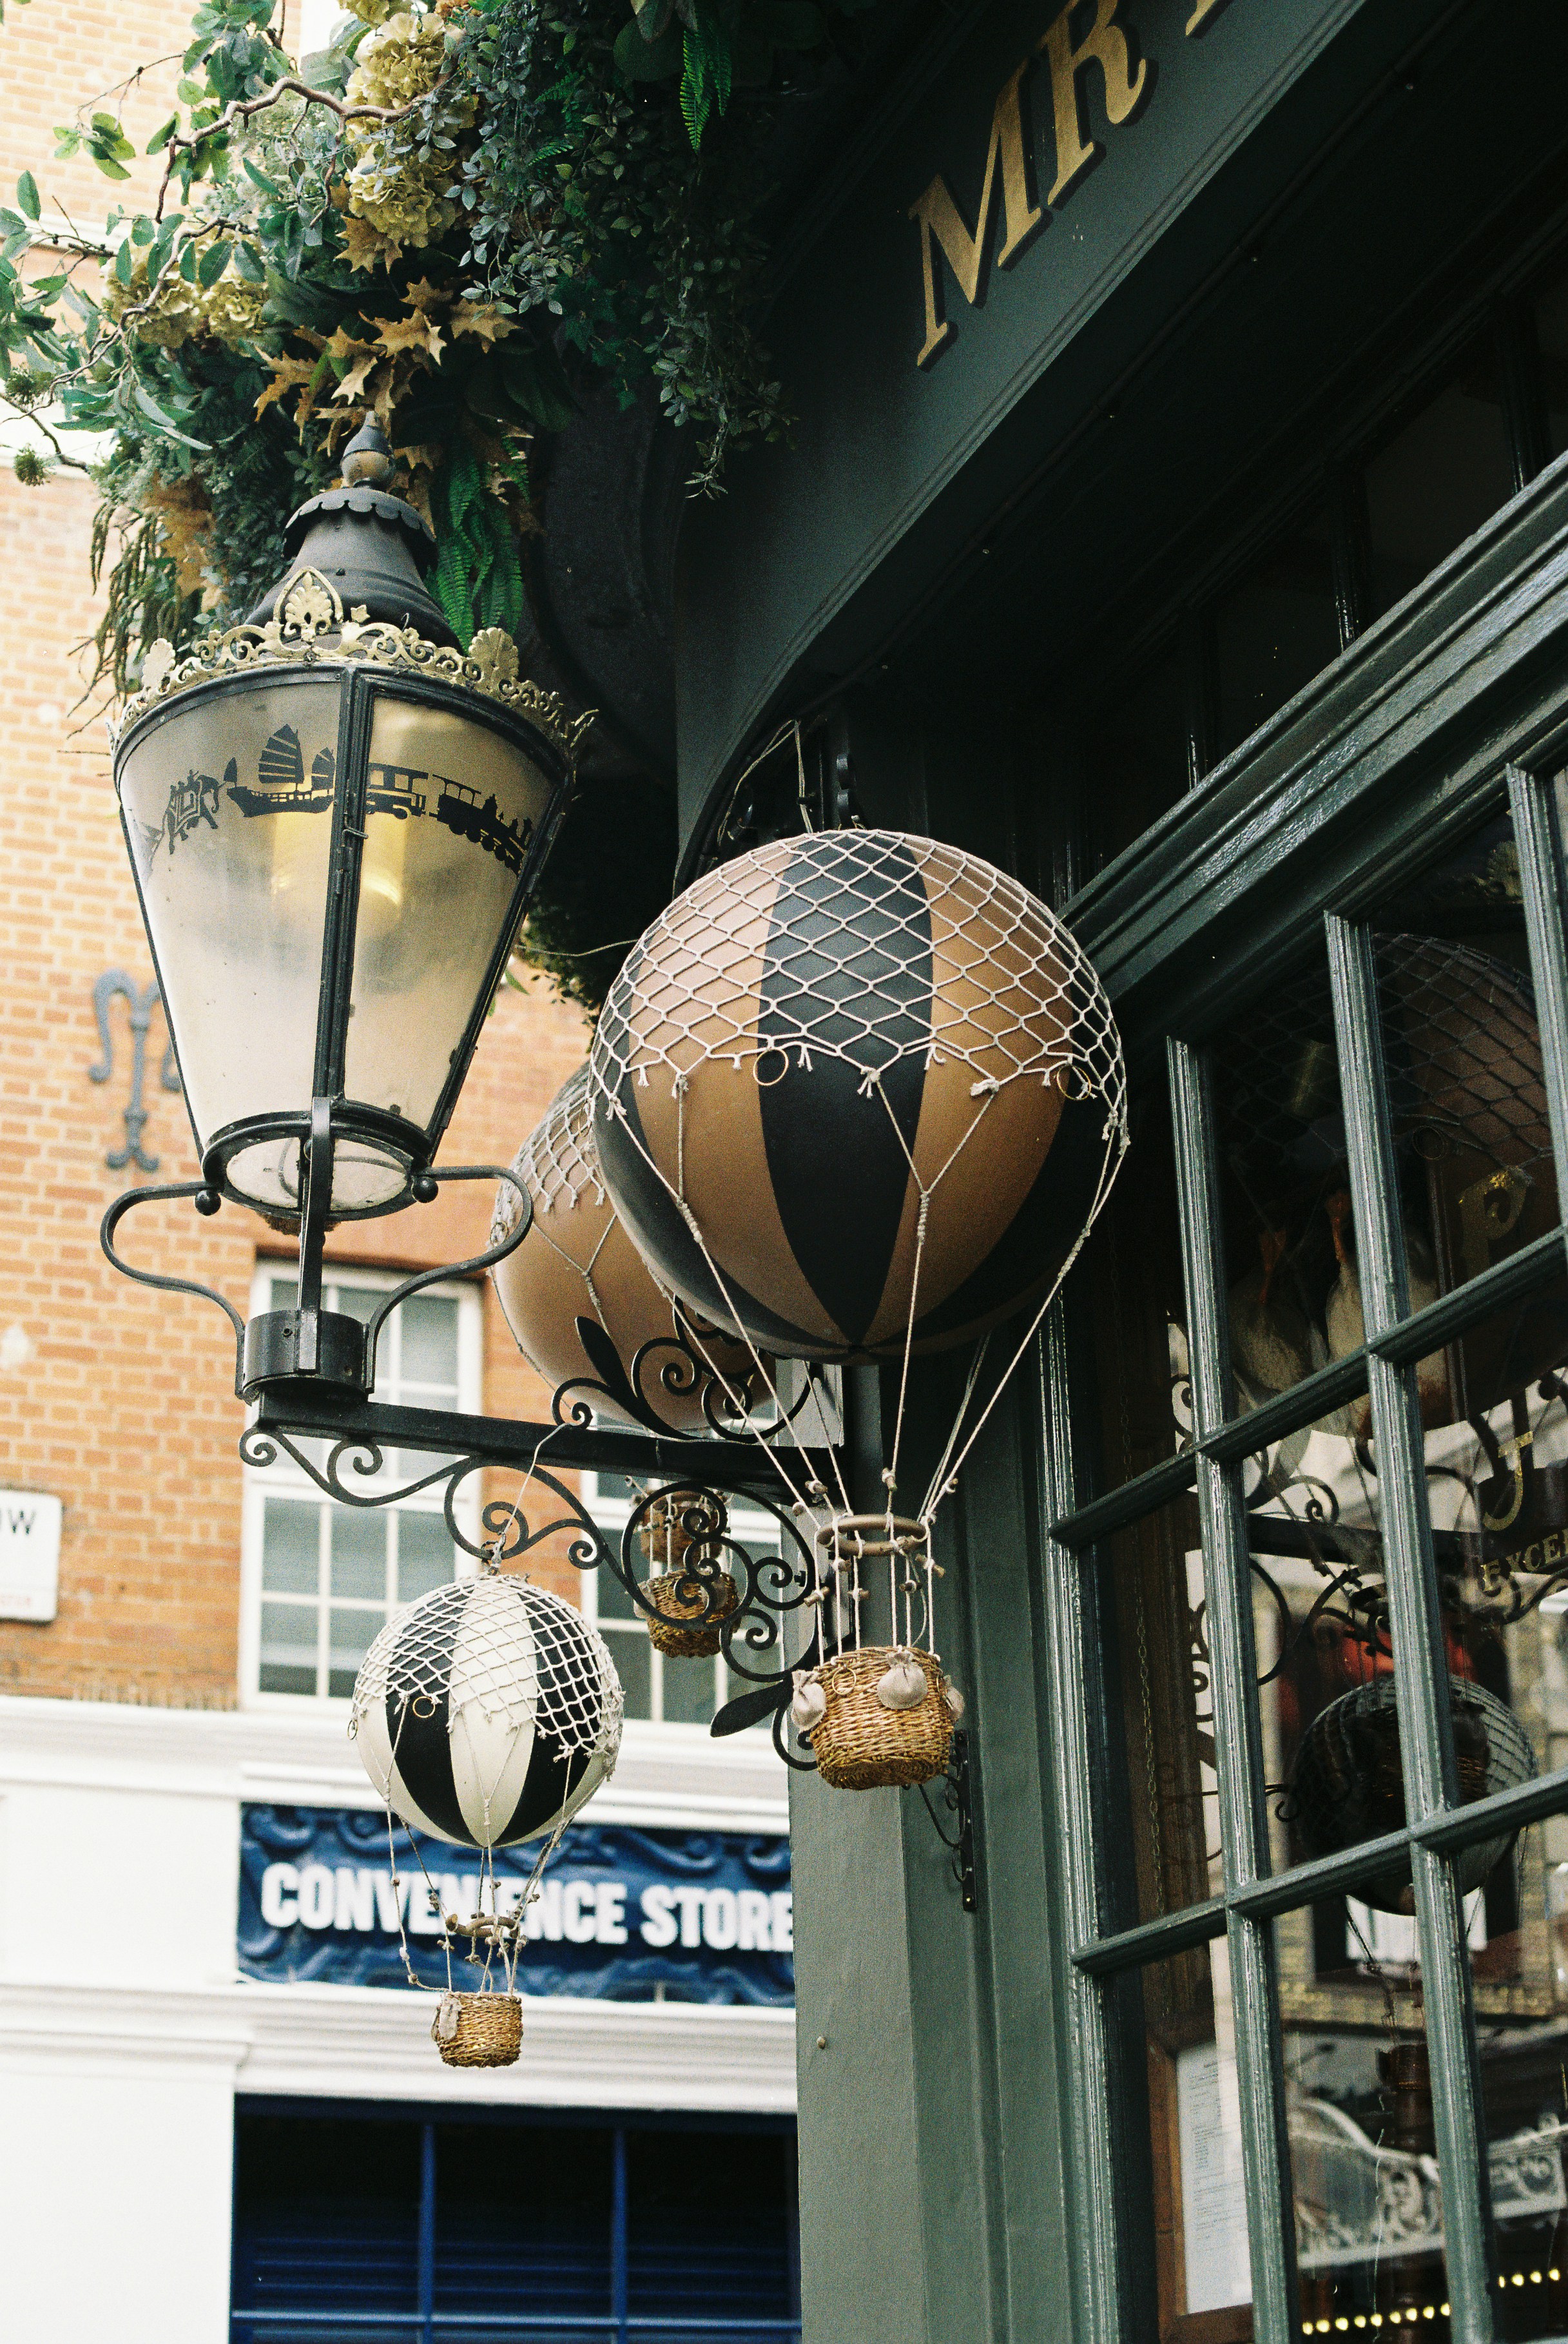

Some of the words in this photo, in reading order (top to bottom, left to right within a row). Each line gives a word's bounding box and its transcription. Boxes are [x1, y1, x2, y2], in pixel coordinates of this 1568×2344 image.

[909, 0, 1147, 366] MR
[0, 1508, 36, 1535] W
[1481, 1530, 1568, 1592] EXCE
[260, 1863, 628, 1945] CONVENIENCE
[641, 1885, 793, 1952] STORE
